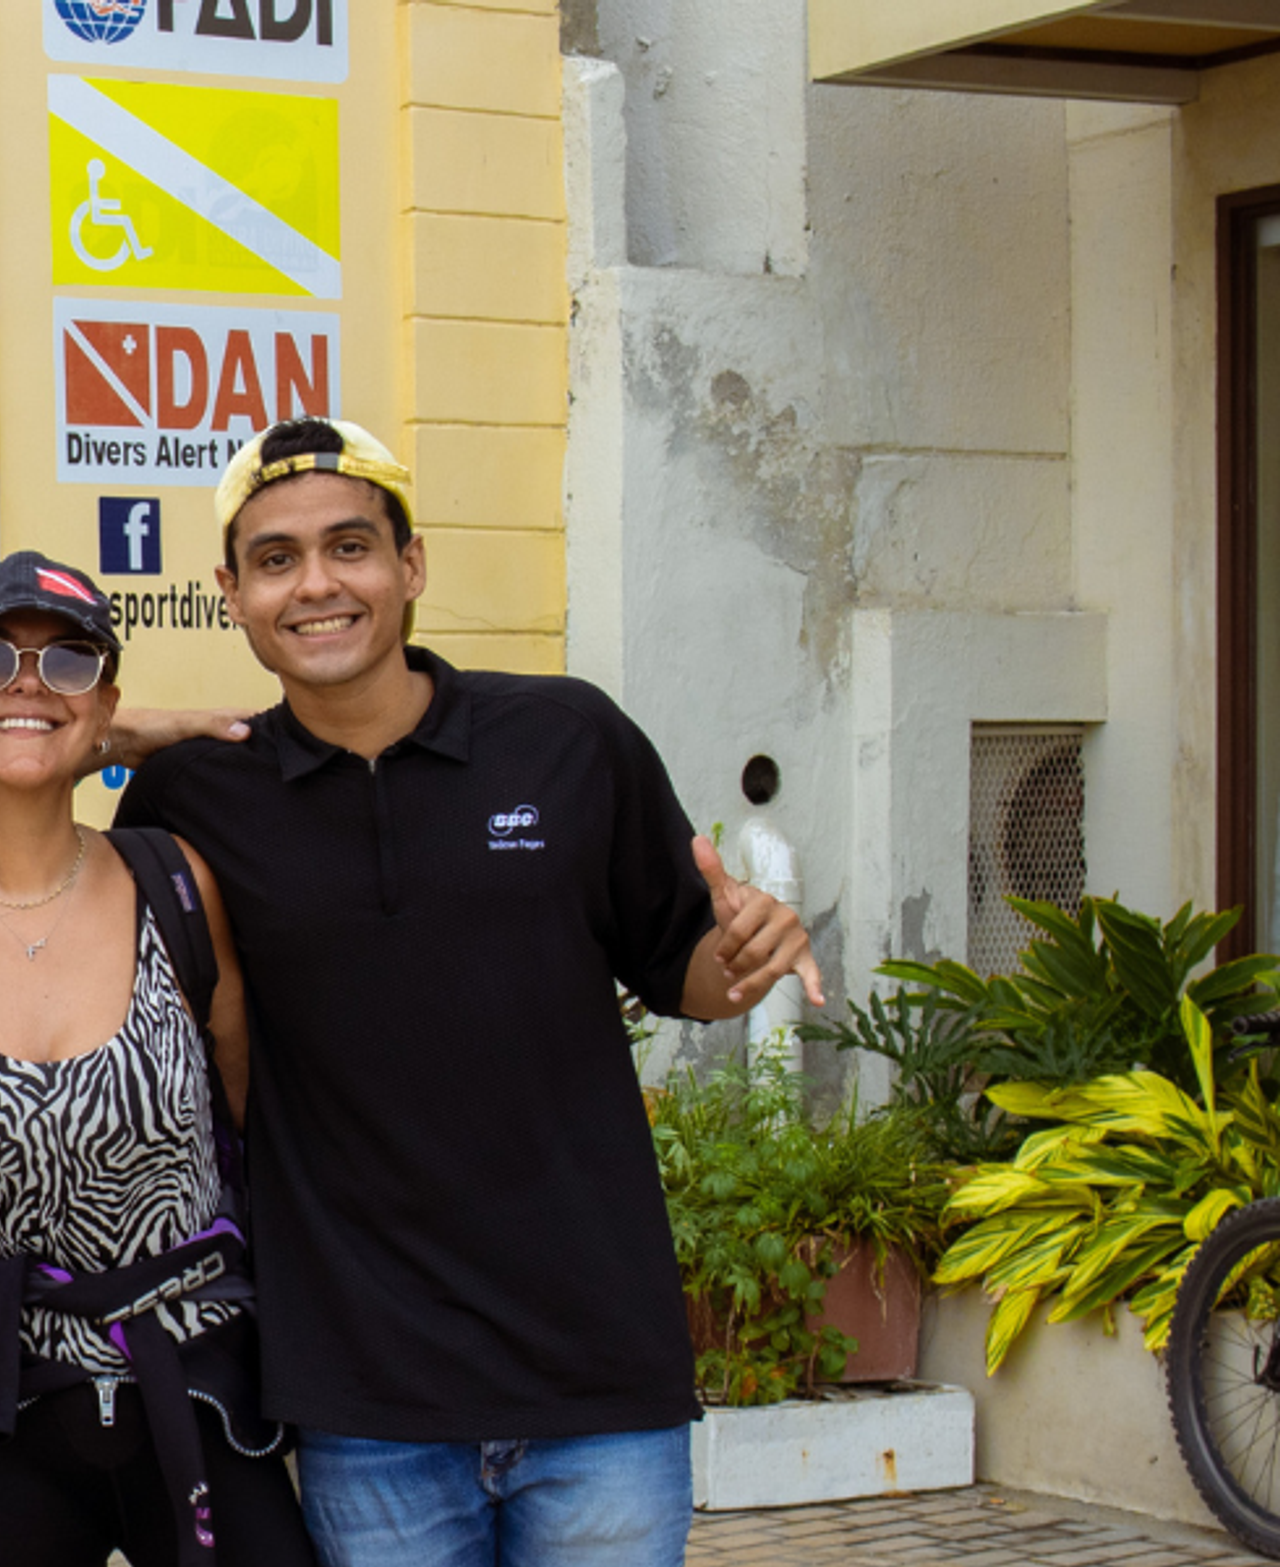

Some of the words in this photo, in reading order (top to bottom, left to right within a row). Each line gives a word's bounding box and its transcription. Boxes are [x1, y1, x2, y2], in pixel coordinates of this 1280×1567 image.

[156, 325, 329, 432] DAN
[67, 433, 146, 466] Divers
[155, 435, 218, 468] Alert
[109, 581, 237, 641] sportdive
